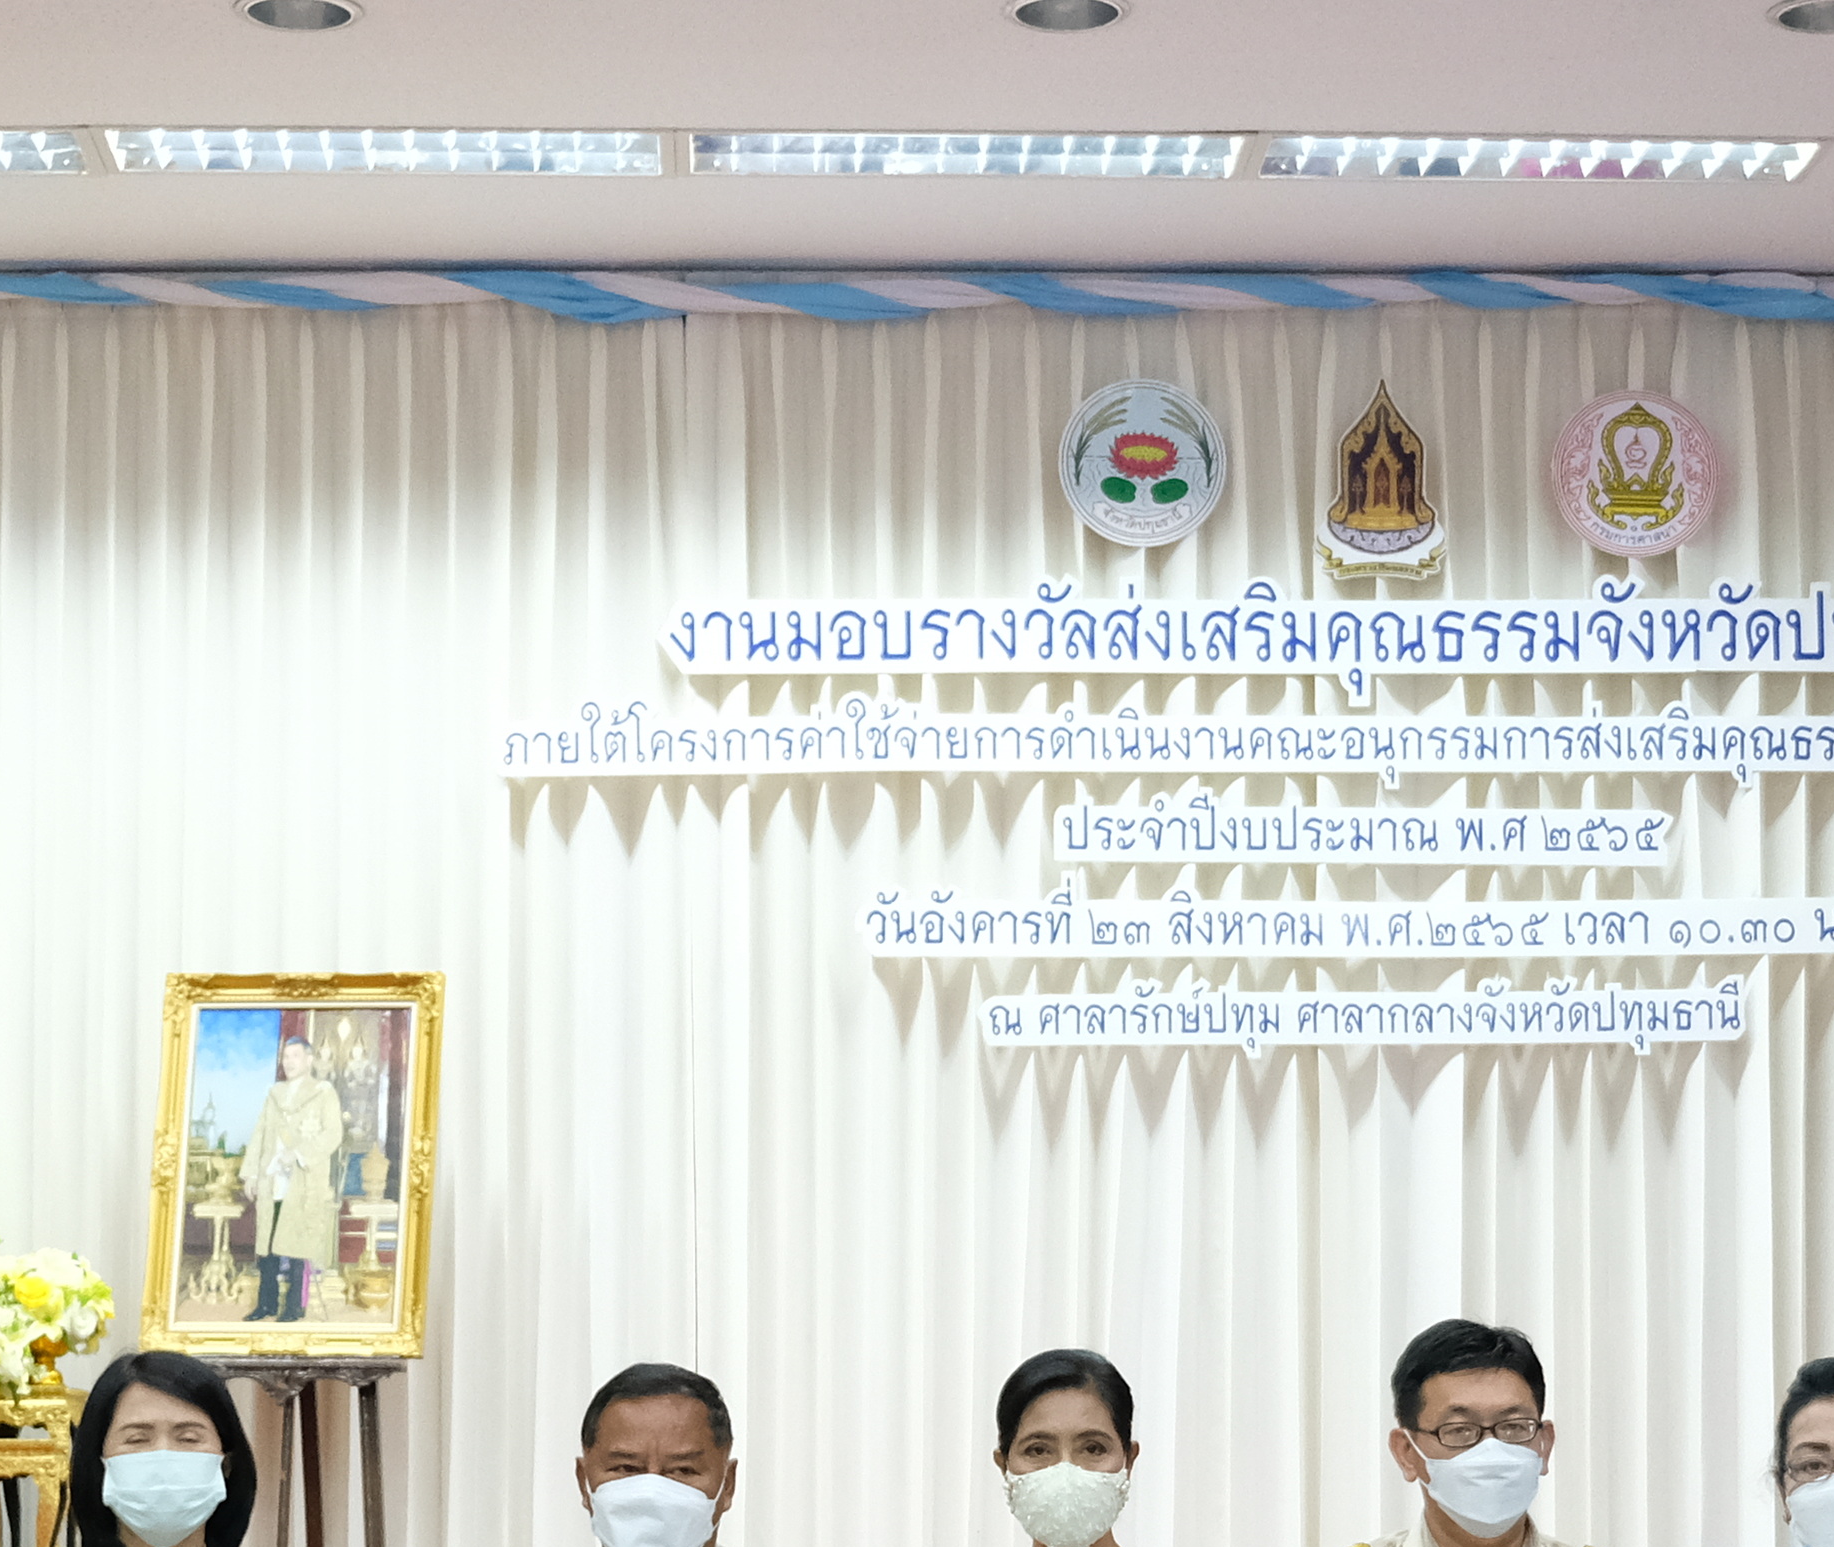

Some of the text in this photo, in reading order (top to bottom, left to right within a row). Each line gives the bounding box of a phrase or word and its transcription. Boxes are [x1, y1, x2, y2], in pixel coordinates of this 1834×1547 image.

[1589, 520, 1679, 546] กรมการศาสนา
[1063, 794, 1666, 853] ประจำปีงบประมาณ พ.ศ ๒๕๖๕
[866, 877, 1073, 945] วันอังคารที่
[1088, 909, 1151, 946] ๒๓
[1168, 890, 1324, 947] สิงหาคม
[1564, 910, 1650, 946] เวลา
[1668, 916, 1796, 949] ๑๐.๓๐
[988, 981, 1741, 1050] ณ ศาลารักษ์ปทุม ศาลากลางจังหวัดปทุมธานี
